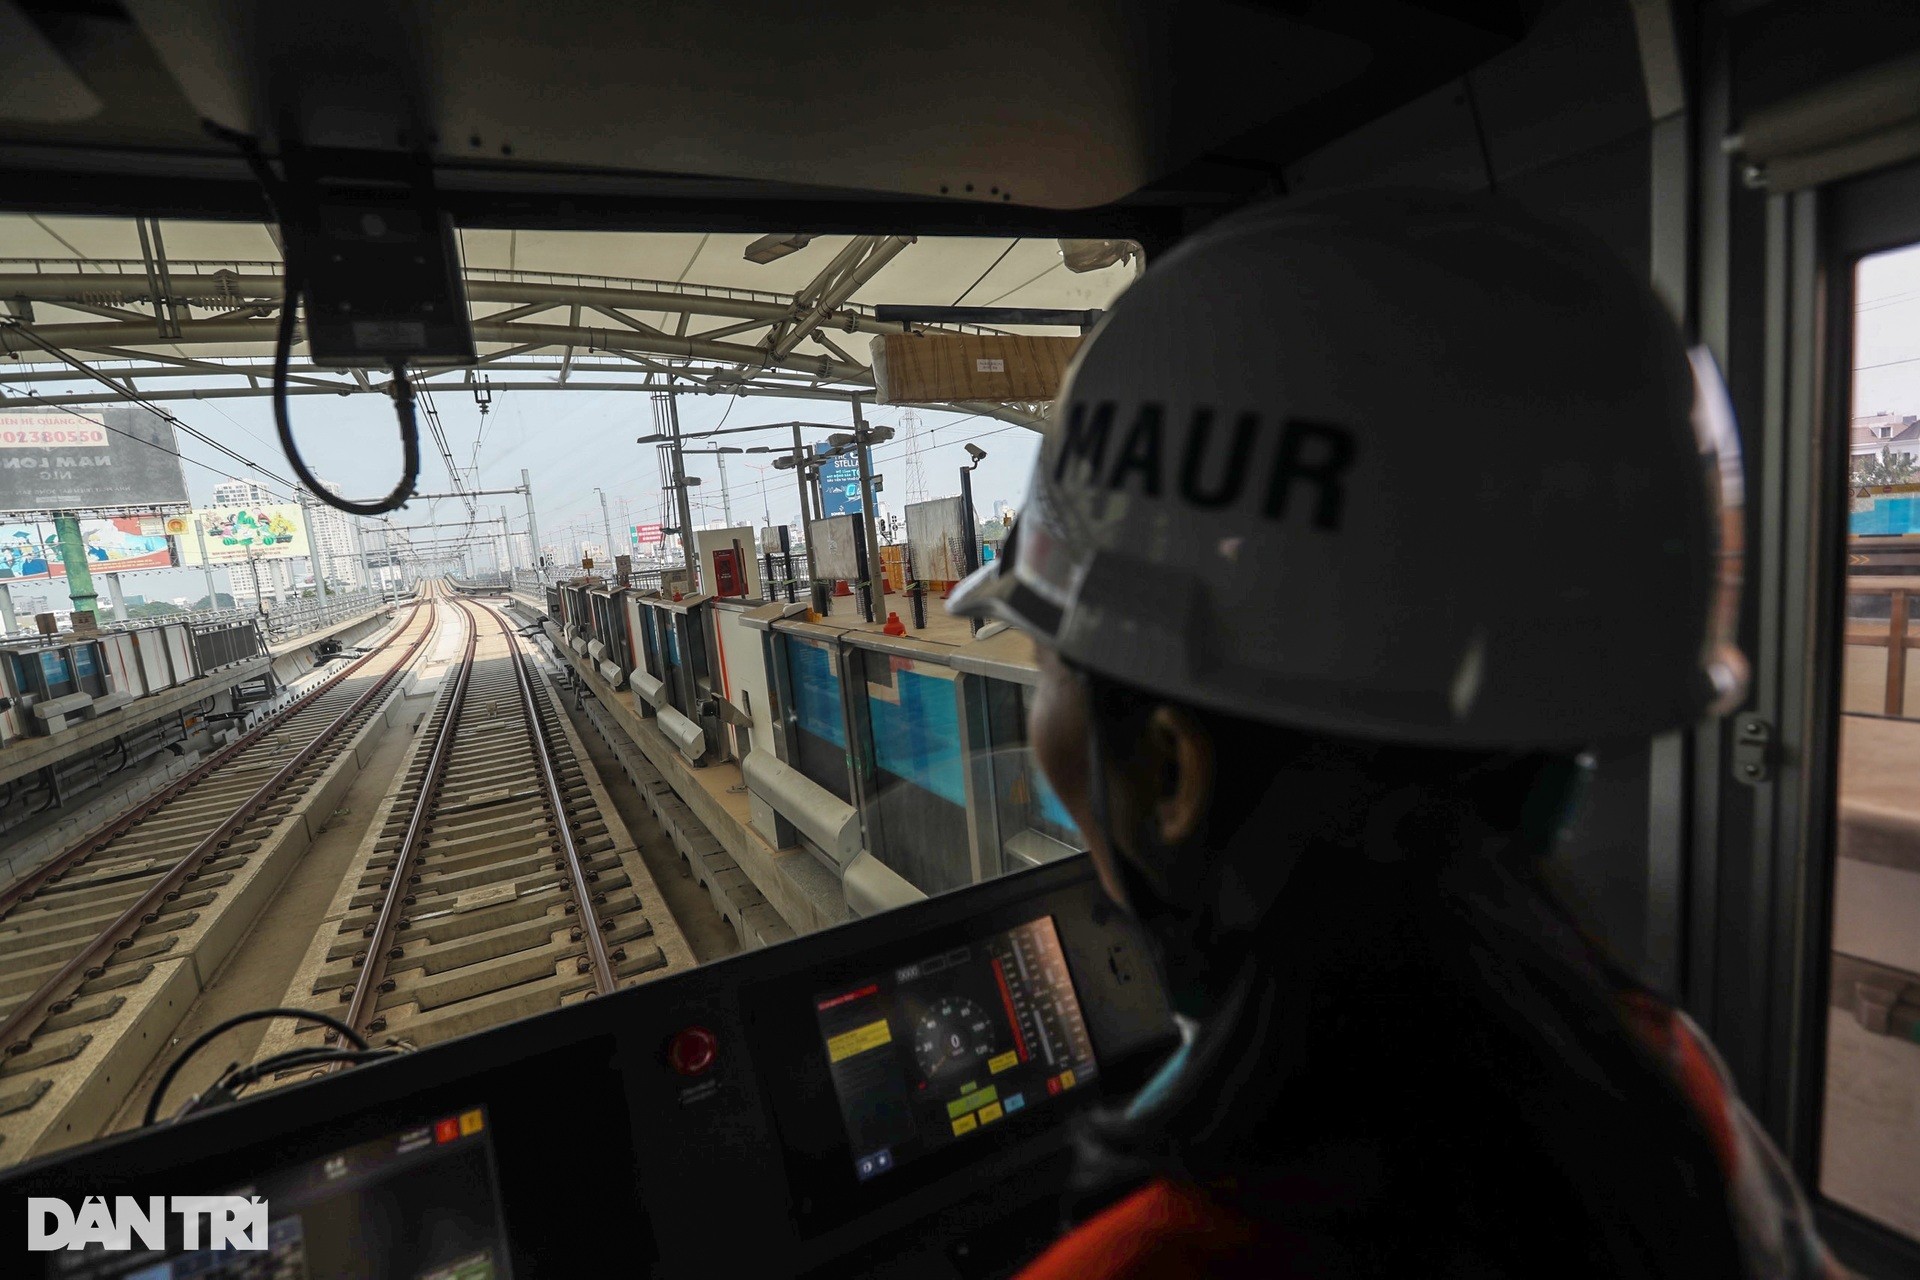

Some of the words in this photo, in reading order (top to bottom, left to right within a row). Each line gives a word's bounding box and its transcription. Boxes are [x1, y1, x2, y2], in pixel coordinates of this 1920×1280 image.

[0, 431, 103, 443] 02380550
[1053, 402, 1356, 532] MAUR
[951, 1034, 960, 1048] 0
